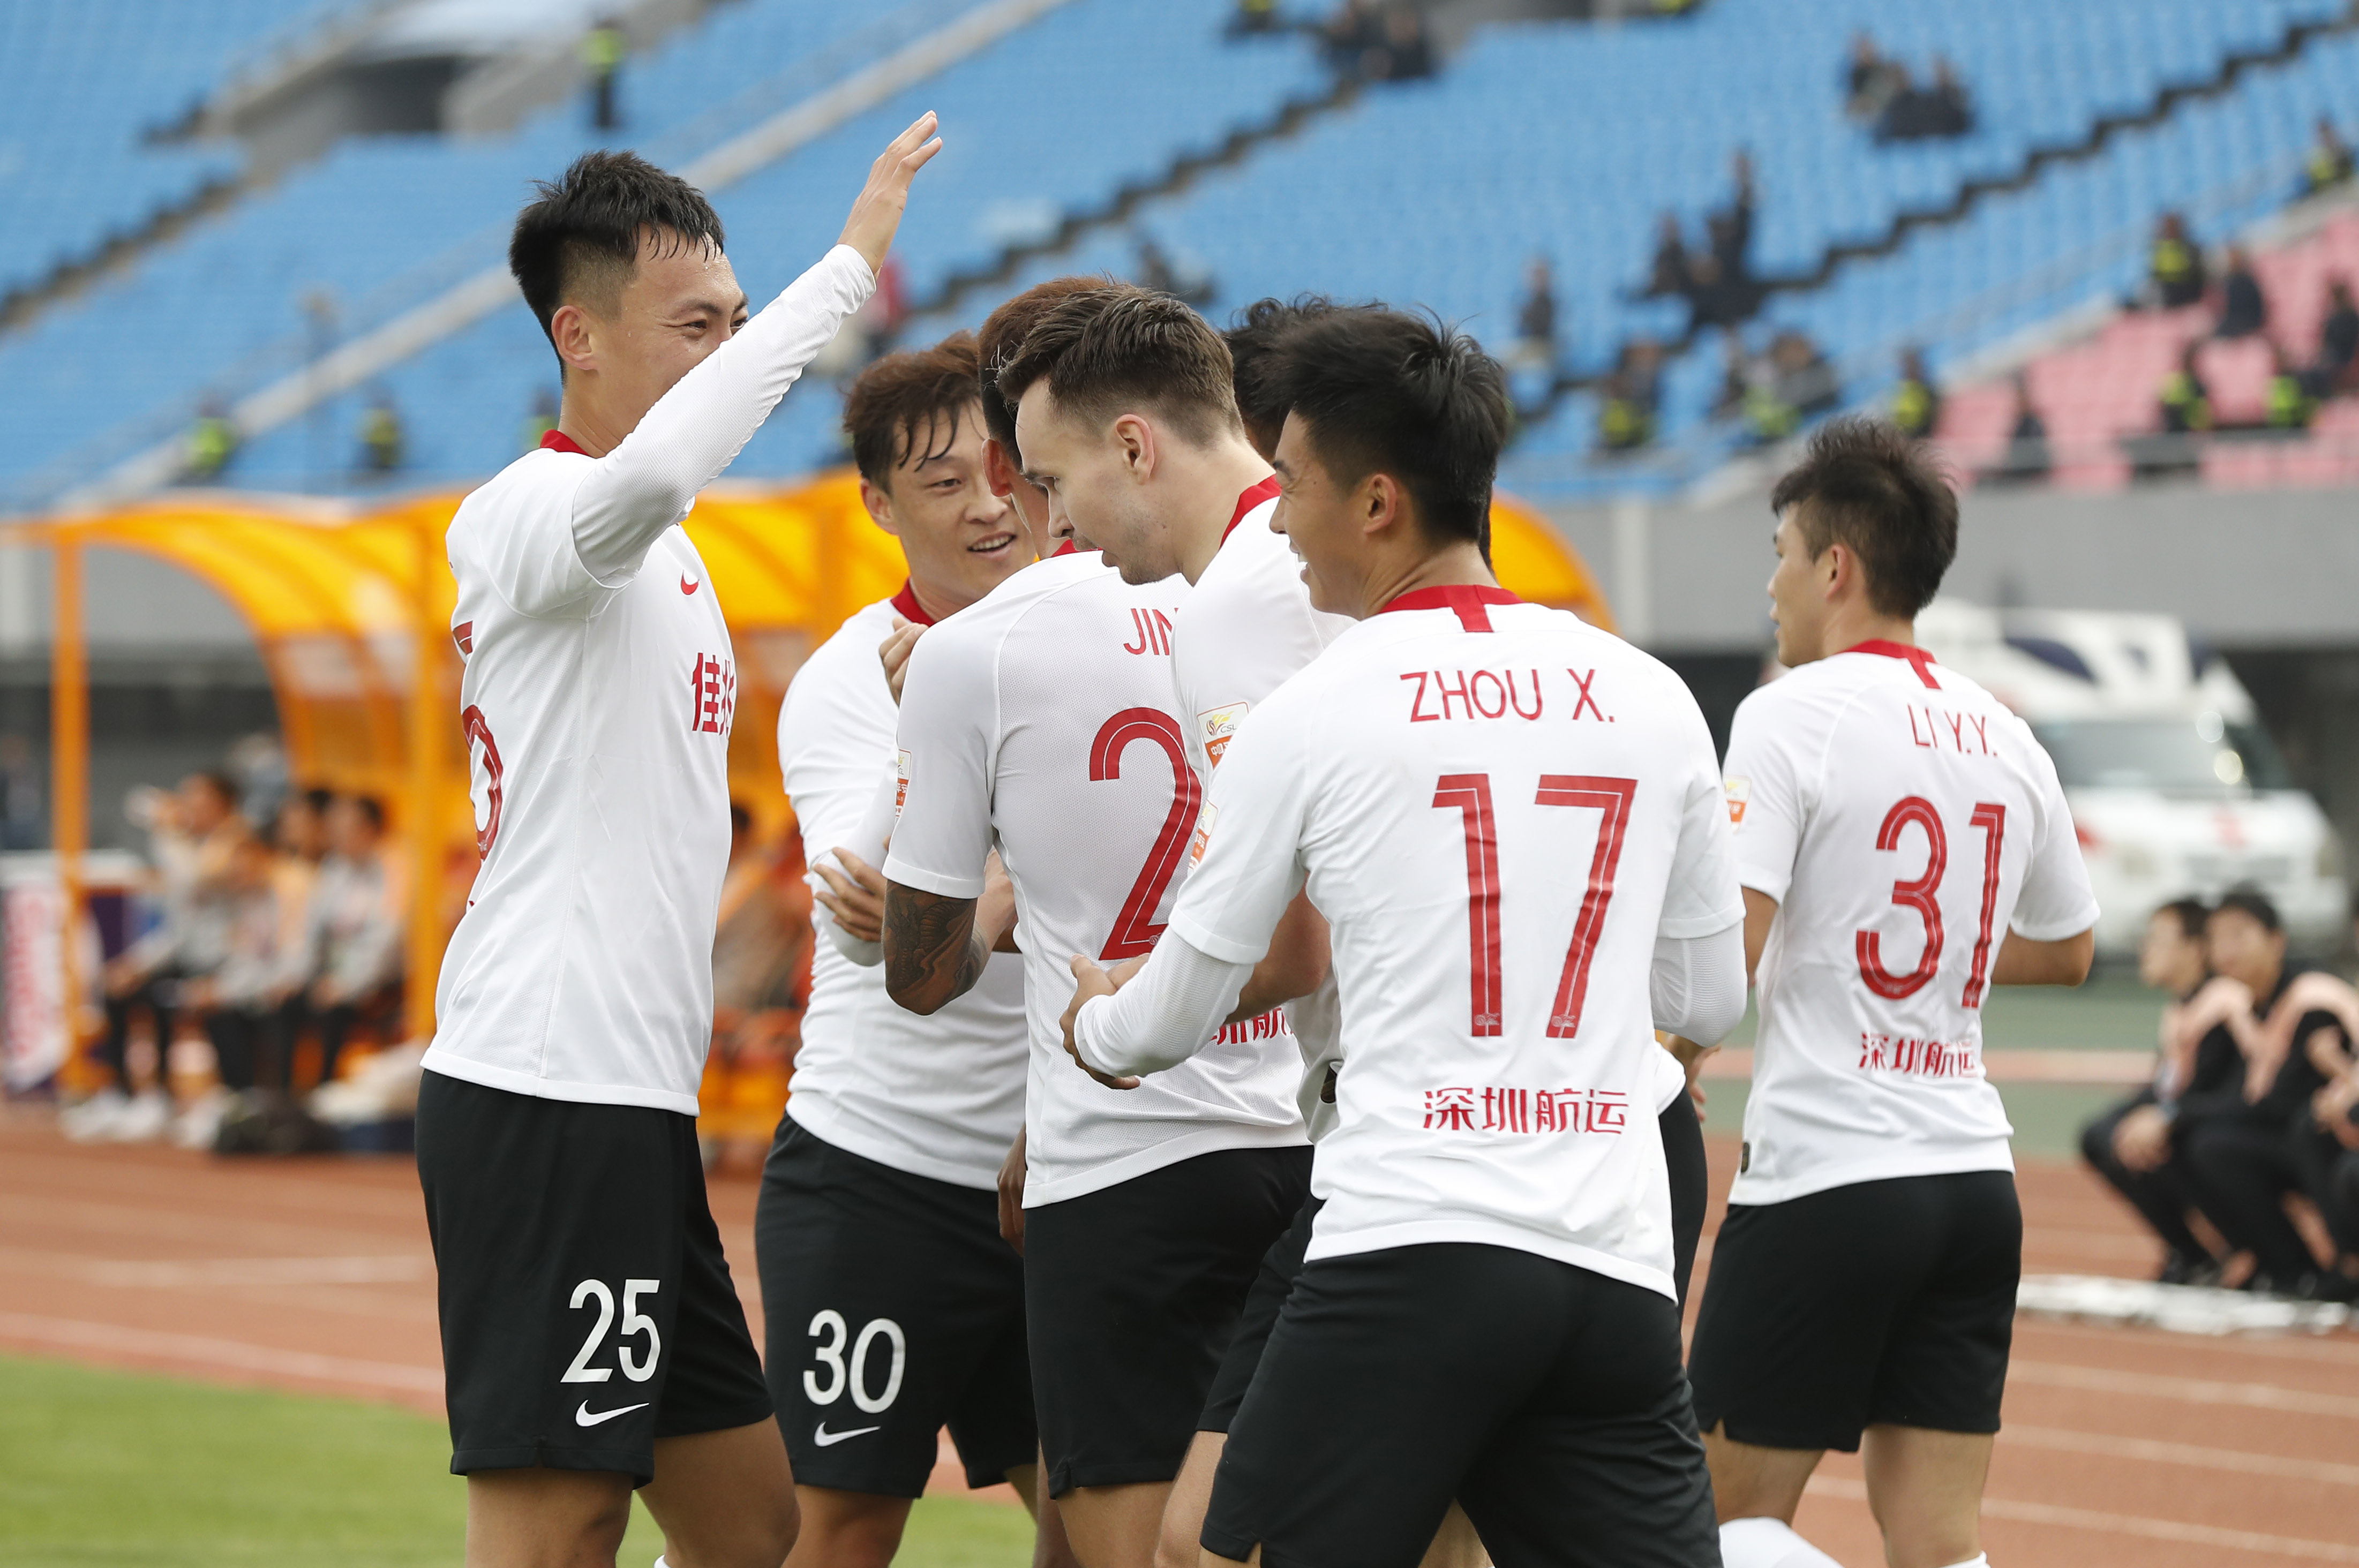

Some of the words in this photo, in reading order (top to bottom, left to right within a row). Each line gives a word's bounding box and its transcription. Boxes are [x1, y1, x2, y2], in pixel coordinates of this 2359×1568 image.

[1400, 669, 1543, 722] ZHOU
[1567, 668, 1614, 722] X.
[1211, 742, 1229, 756] 中国
[1220, 723, 1237, 733] CSL
[1907, 704, 1938, 749] LI
[1432, 773, 1638, 1039] 17
[1855, 795, 2006, 1009] 31
[1423, 1087, 1629, 1134] 深圳航运
[560, 1279, 660, 1383] 25
[803, 1309, 906, 1414] 30
